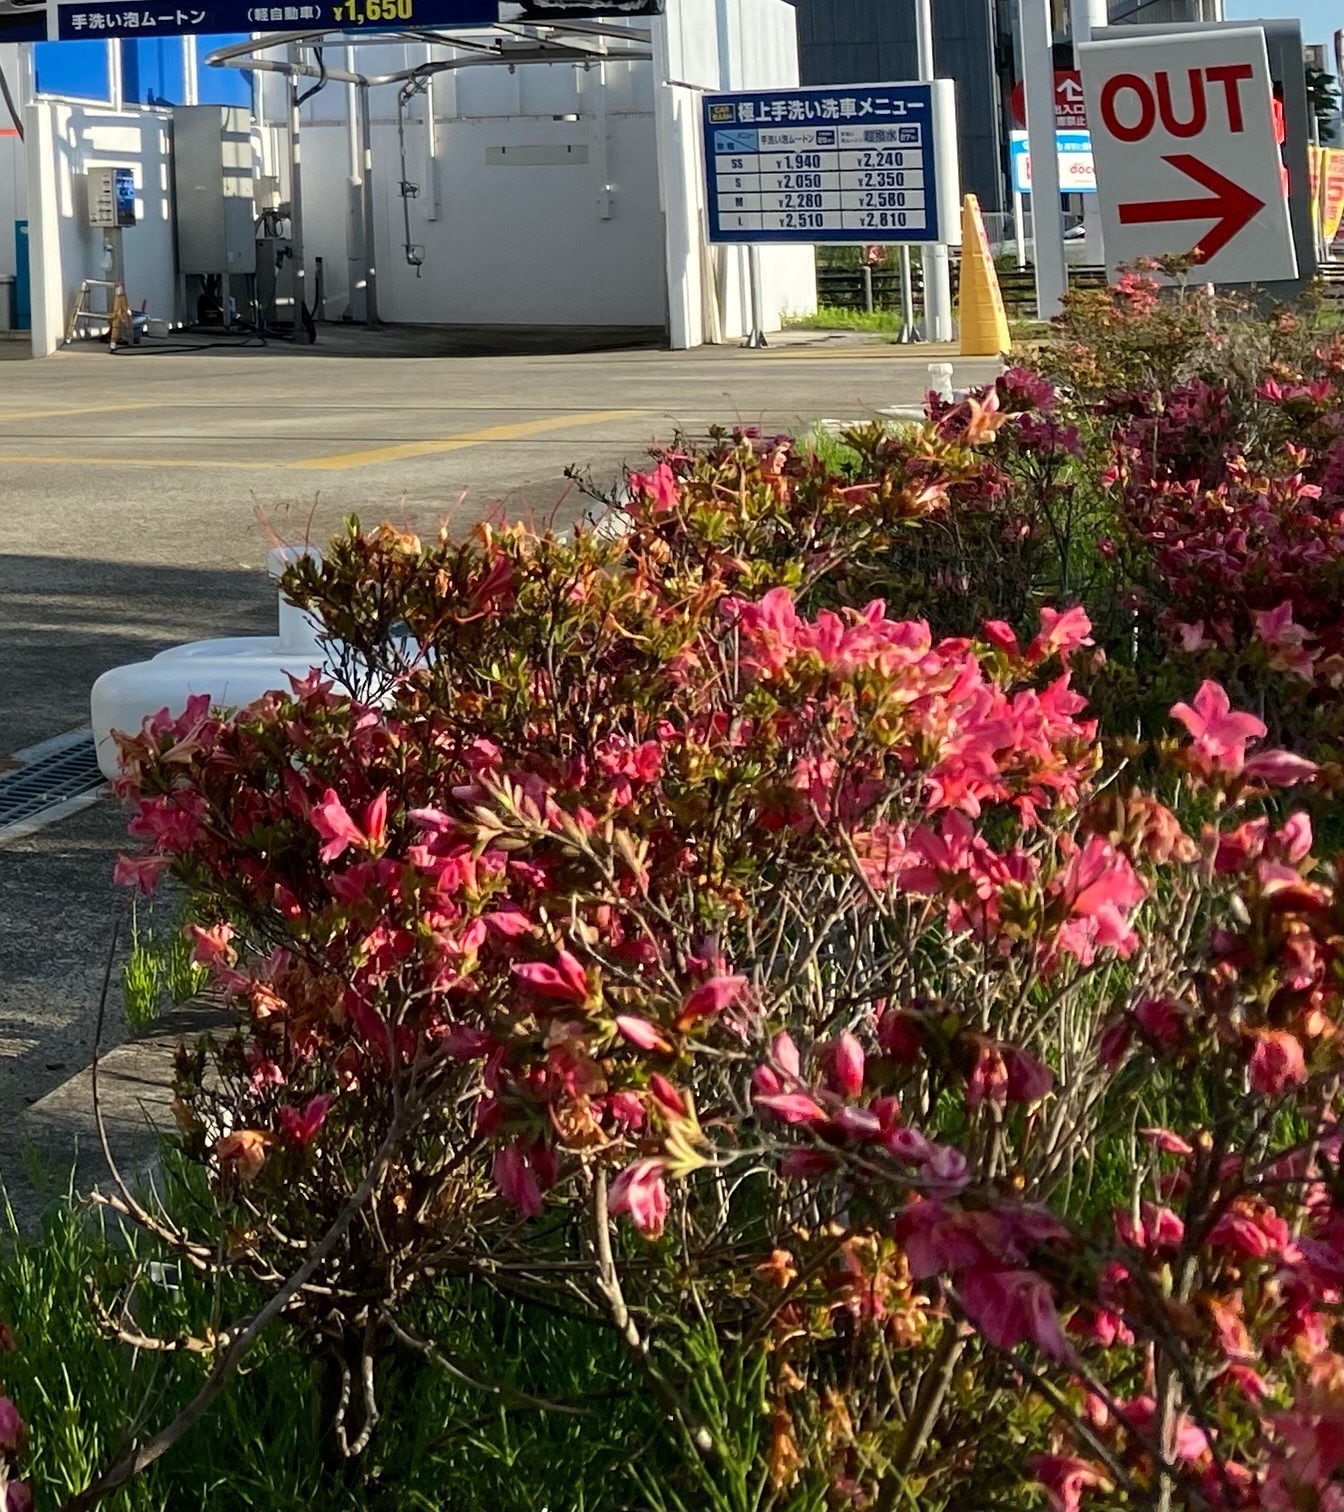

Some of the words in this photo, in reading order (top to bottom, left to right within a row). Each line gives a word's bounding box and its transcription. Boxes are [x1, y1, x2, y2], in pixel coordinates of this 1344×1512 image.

[71, 9, 206, 31] 手洗い泡ムートン
[738, 97, 925, 123] 極上手洗い洗車メニュー
[1100, 64, 1254, 143] OUT
[731, 158, 744, 169] SS
